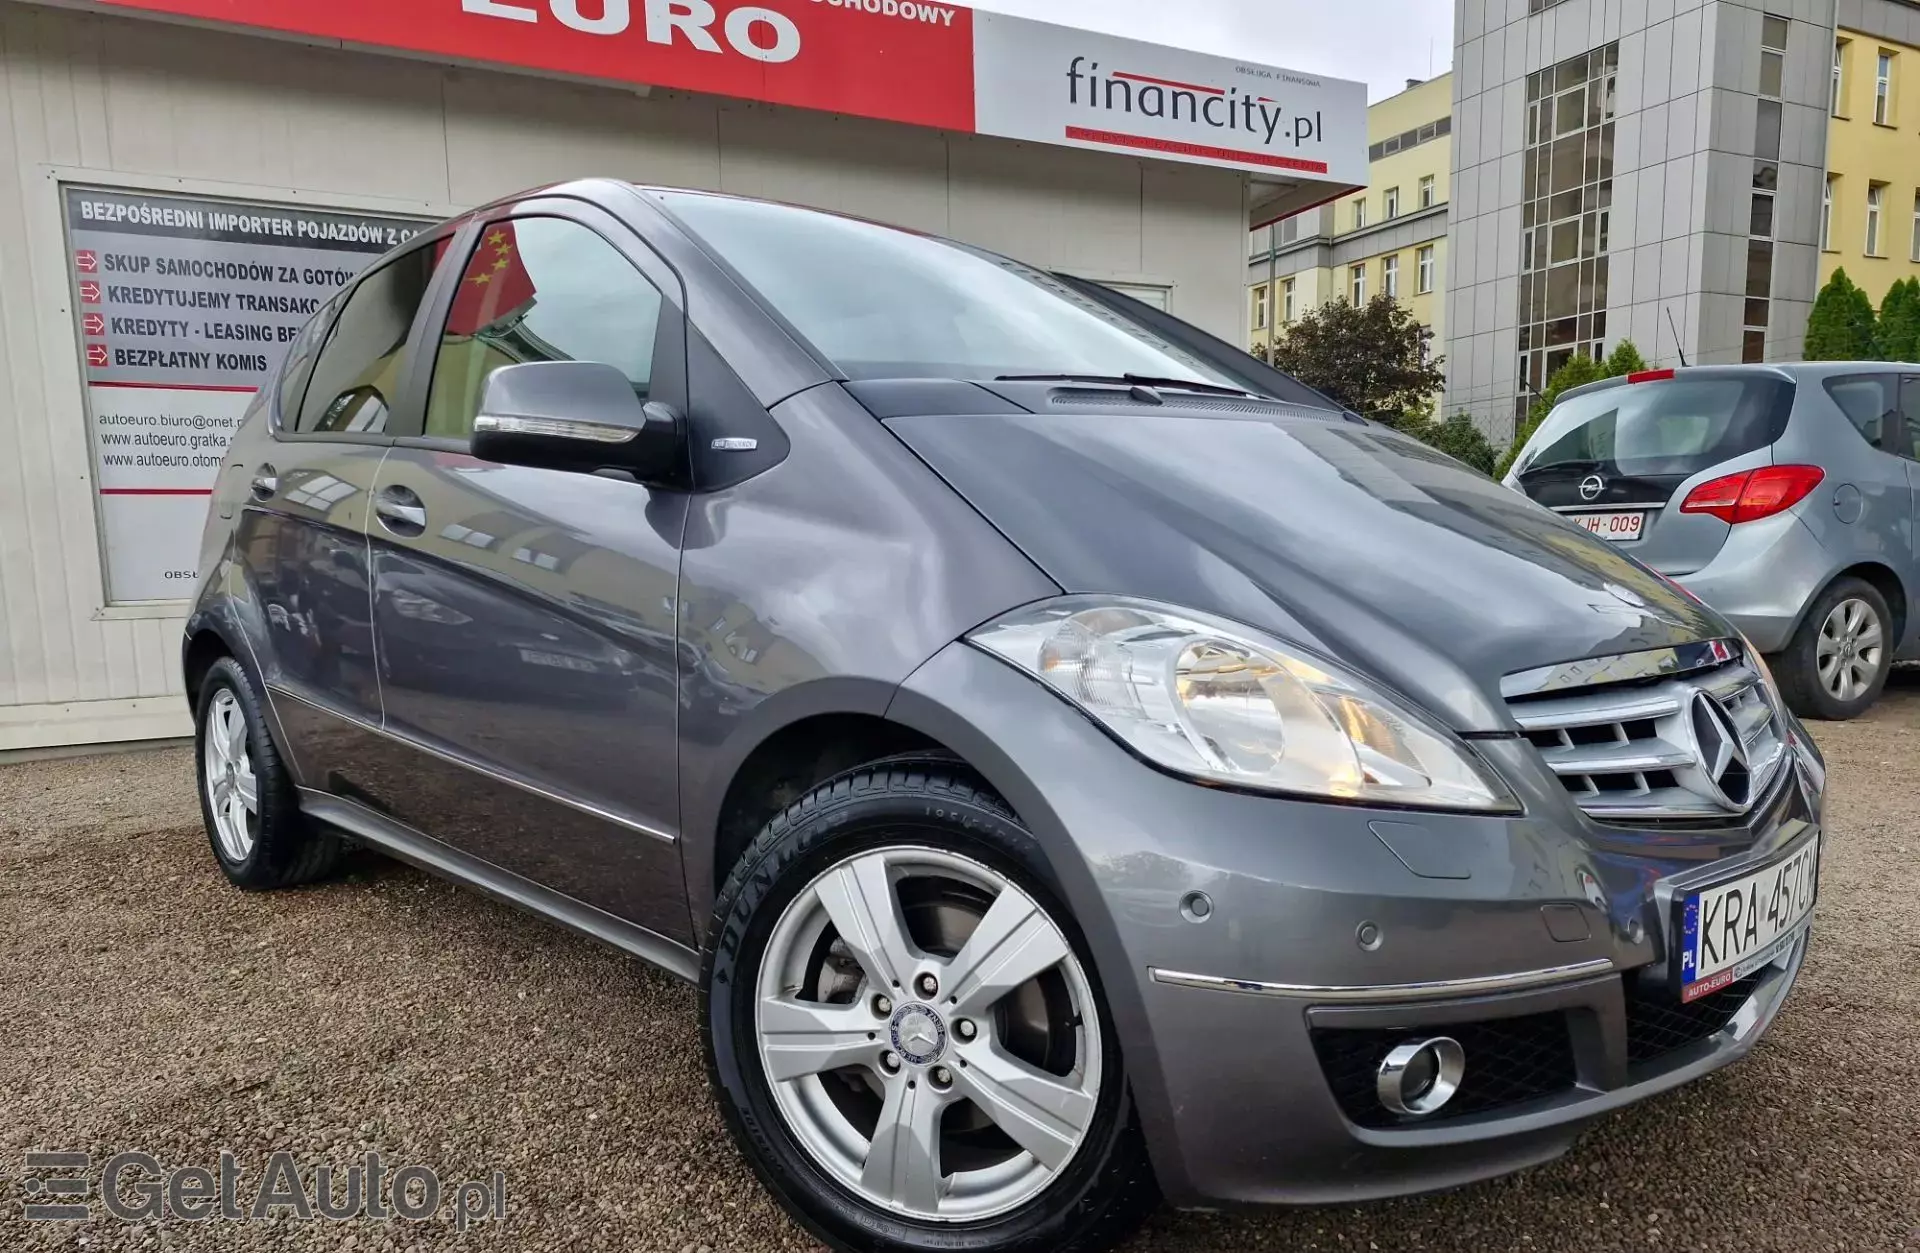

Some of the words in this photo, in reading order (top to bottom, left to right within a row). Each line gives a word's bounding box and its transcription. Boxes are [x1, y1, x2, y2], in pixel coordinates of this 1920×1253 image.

[1066, 56, 1321, 147] financity.pl
[81, 201, 203, 229] BEZPOŚREDNI
[208, 212, 293, 236] IMPORTER
[298, 221, 383, 244] POJAZDÓW
[387, 228, 397, 245] Z
[104, 253, 150, 273] SKUP
[156, 257, 274, 282] SAMOCHODÓW
[278, 266, 299, 283] ZA
[107, 285, 230, 309] KREDYTUJEMY
[111, 317, 189, 337] KREDYTY
[204, 322, 273, 342] LEASING
[277, 326, 301, 343] BE
[115, 348, 210, 369] BEZPŁATNY
[216, 353, 267, 371] KOMIS
[101, 432, 233, 450] www.autoeuro.gratka.
[1700, 881, 1758, 971] KRA
[1682, 950, 1695, 972] PL
[1688, 972, 1731, 997] AUTO-EURO
